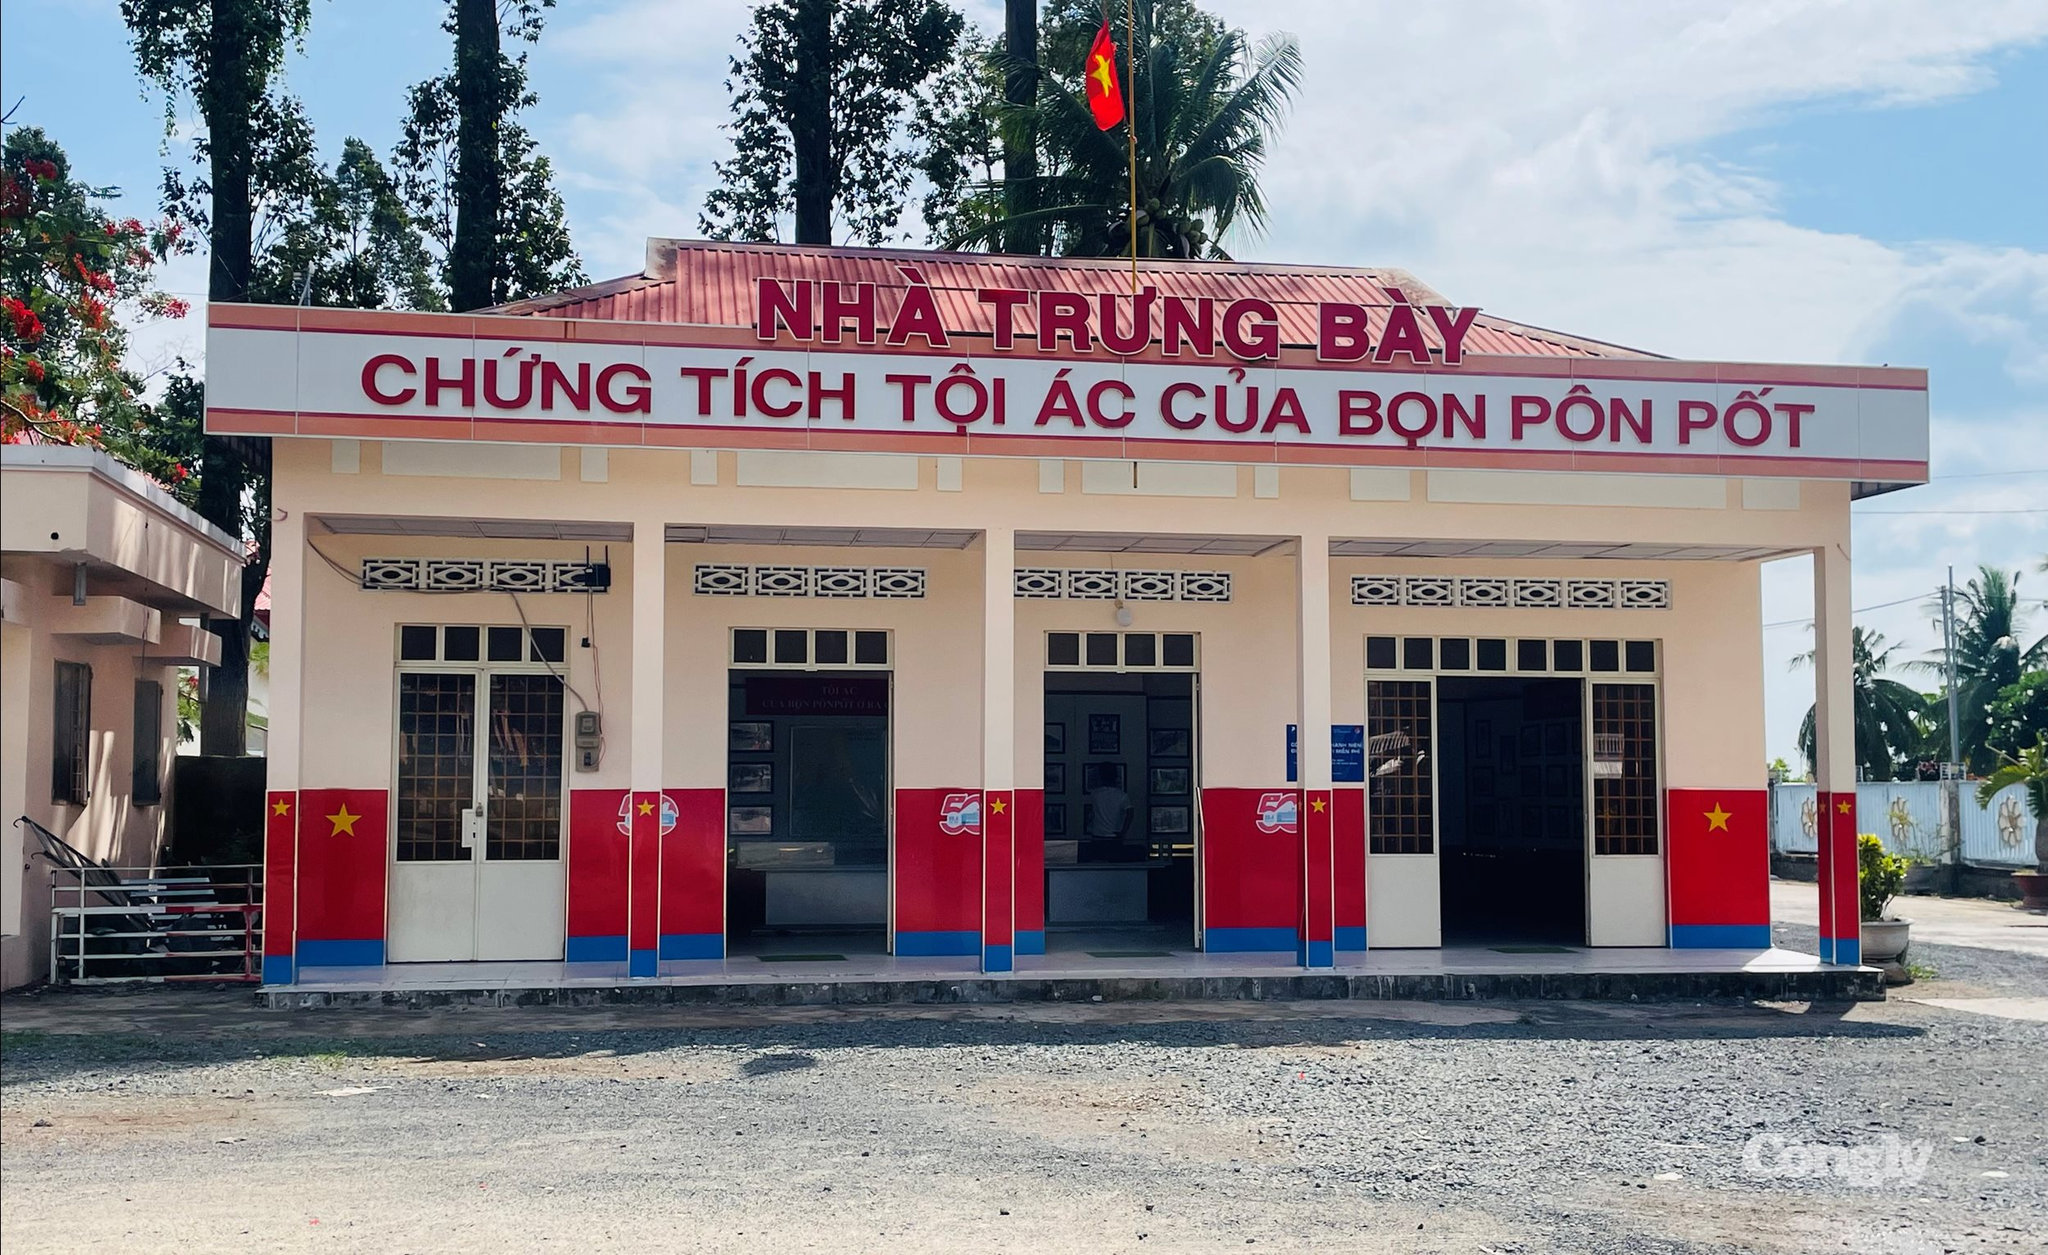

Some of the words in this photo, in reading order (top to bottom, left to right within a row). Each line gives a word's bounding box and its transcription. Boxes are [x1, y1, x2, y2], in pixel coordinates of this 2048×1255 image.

[756, 265, 951, 349] NHÀ
[976, 285, 1280, 362] TRƯNG
[1316, 287, 1482, 366] BÀY
[361, 346, 651, 414] CHỨNG
[681, 356, 855, 421] TÍCH
[886, 363, 1005, 436] TỘI
[1034, 367, 1136, 429] ÁC
[1160, 366, 1311, 435] CỦA
[1339, 389, 1488, 450] BỌN
[1511, 384, 1654, 445] PÔN
[1678, 386, 1816, 448] PỐT
